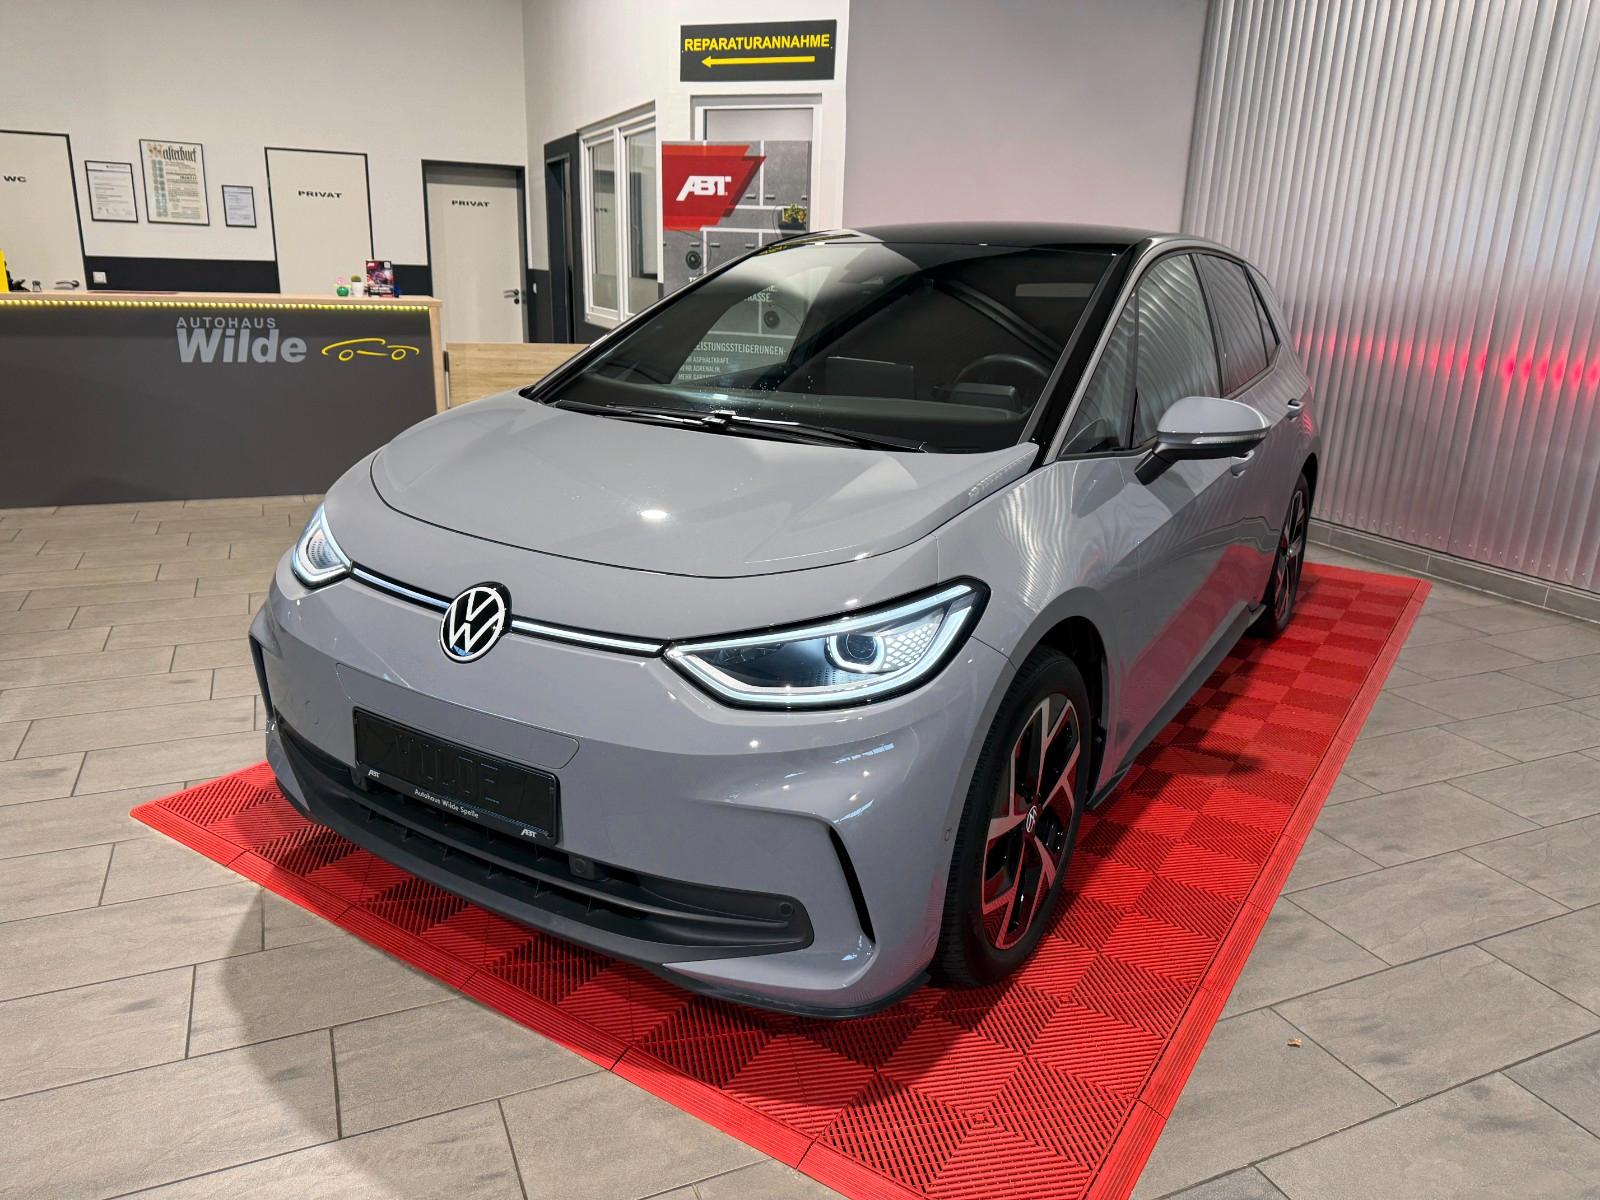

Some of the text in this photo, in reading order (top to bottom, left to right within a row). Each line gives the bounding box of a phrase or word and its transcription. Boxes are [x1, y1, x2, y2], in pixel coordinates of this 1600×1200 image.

[684, 34, 830, 51] REPARATURANNAHME
[3, 175, 27, 183] WC
[298, 190, 342, 198] PRIVAT
[676, 175, 732, 201] ABT
[451, 199, 490, 207] PRIVAT
[176, 316, 277, 329] AUTOHAUS
[176, 328, 307, 363] Wilde
[414, 788, 441, 805] Autohaus
[442, 799, 460, 812] Wilde
